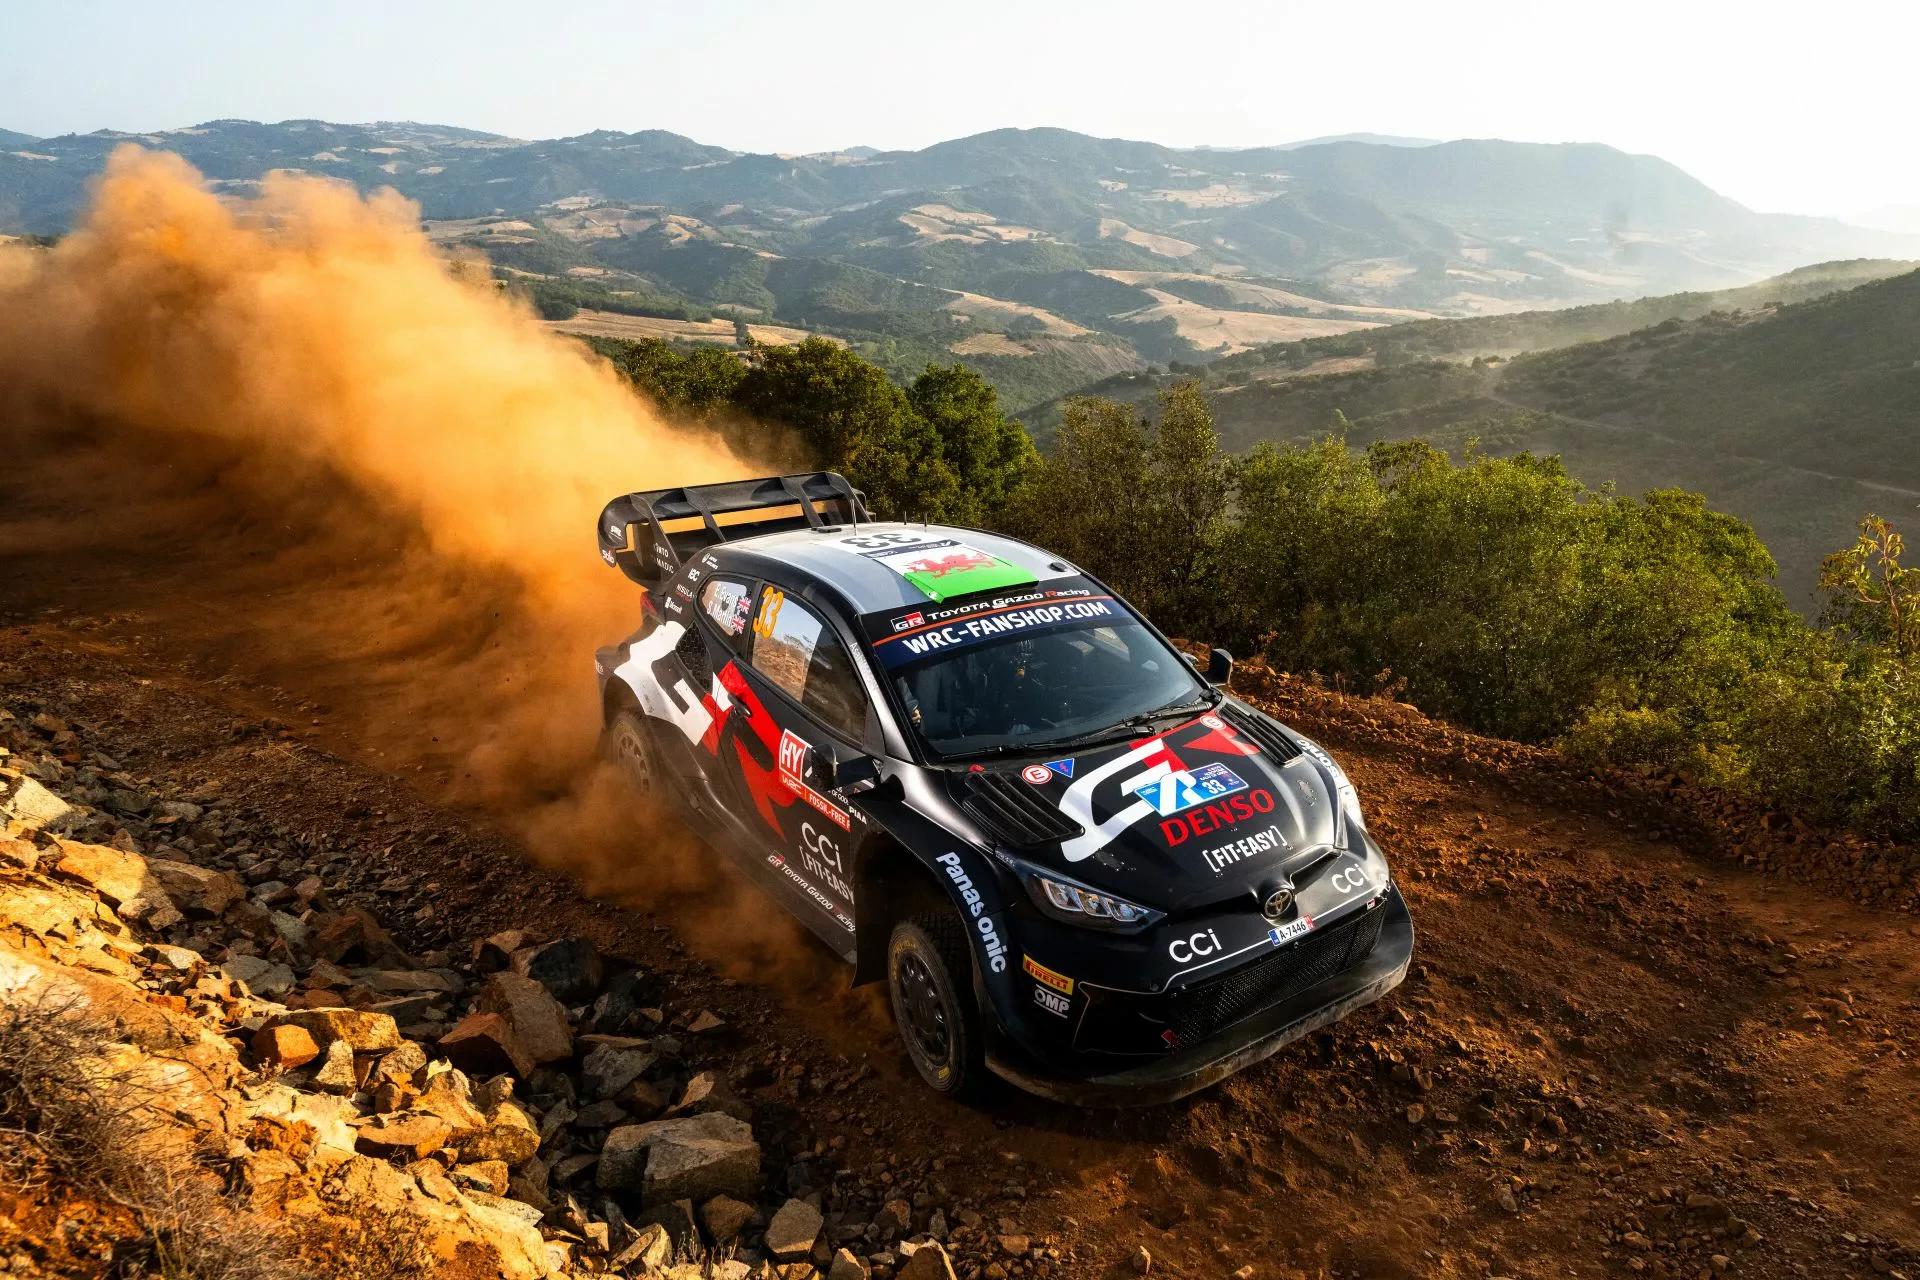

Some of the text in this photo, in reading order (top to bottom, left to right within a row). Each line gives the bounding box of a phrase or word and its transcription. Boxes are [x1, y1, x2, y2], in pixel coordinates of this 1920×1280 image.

[840, 533, 922, 549] 33
[753, 585, 784, 638] 33
[892, 588, 1091, 632] GR TOYOTA GAZOO Racing
[902, 600, 1113, 654] WRC-FANSHOP.COM
[1202, 779, 1226, 795] 33
[809, 793, 846, 826] FOSSIL-FREE
[849, 805, 868, 825] PIAA
[1159, 789, 1275, 847] DENSO
[780, 863, 808, 889] TOYOTA
[806, 886, 834, 910] GAZOO
[935, 851, 1008, 974] Panasonic
[1279, 921, 1307, 941] A-7446
[1025, 959, 1069, 990] PIRELLI
[1034, 988, 1070, 1013] OMP
